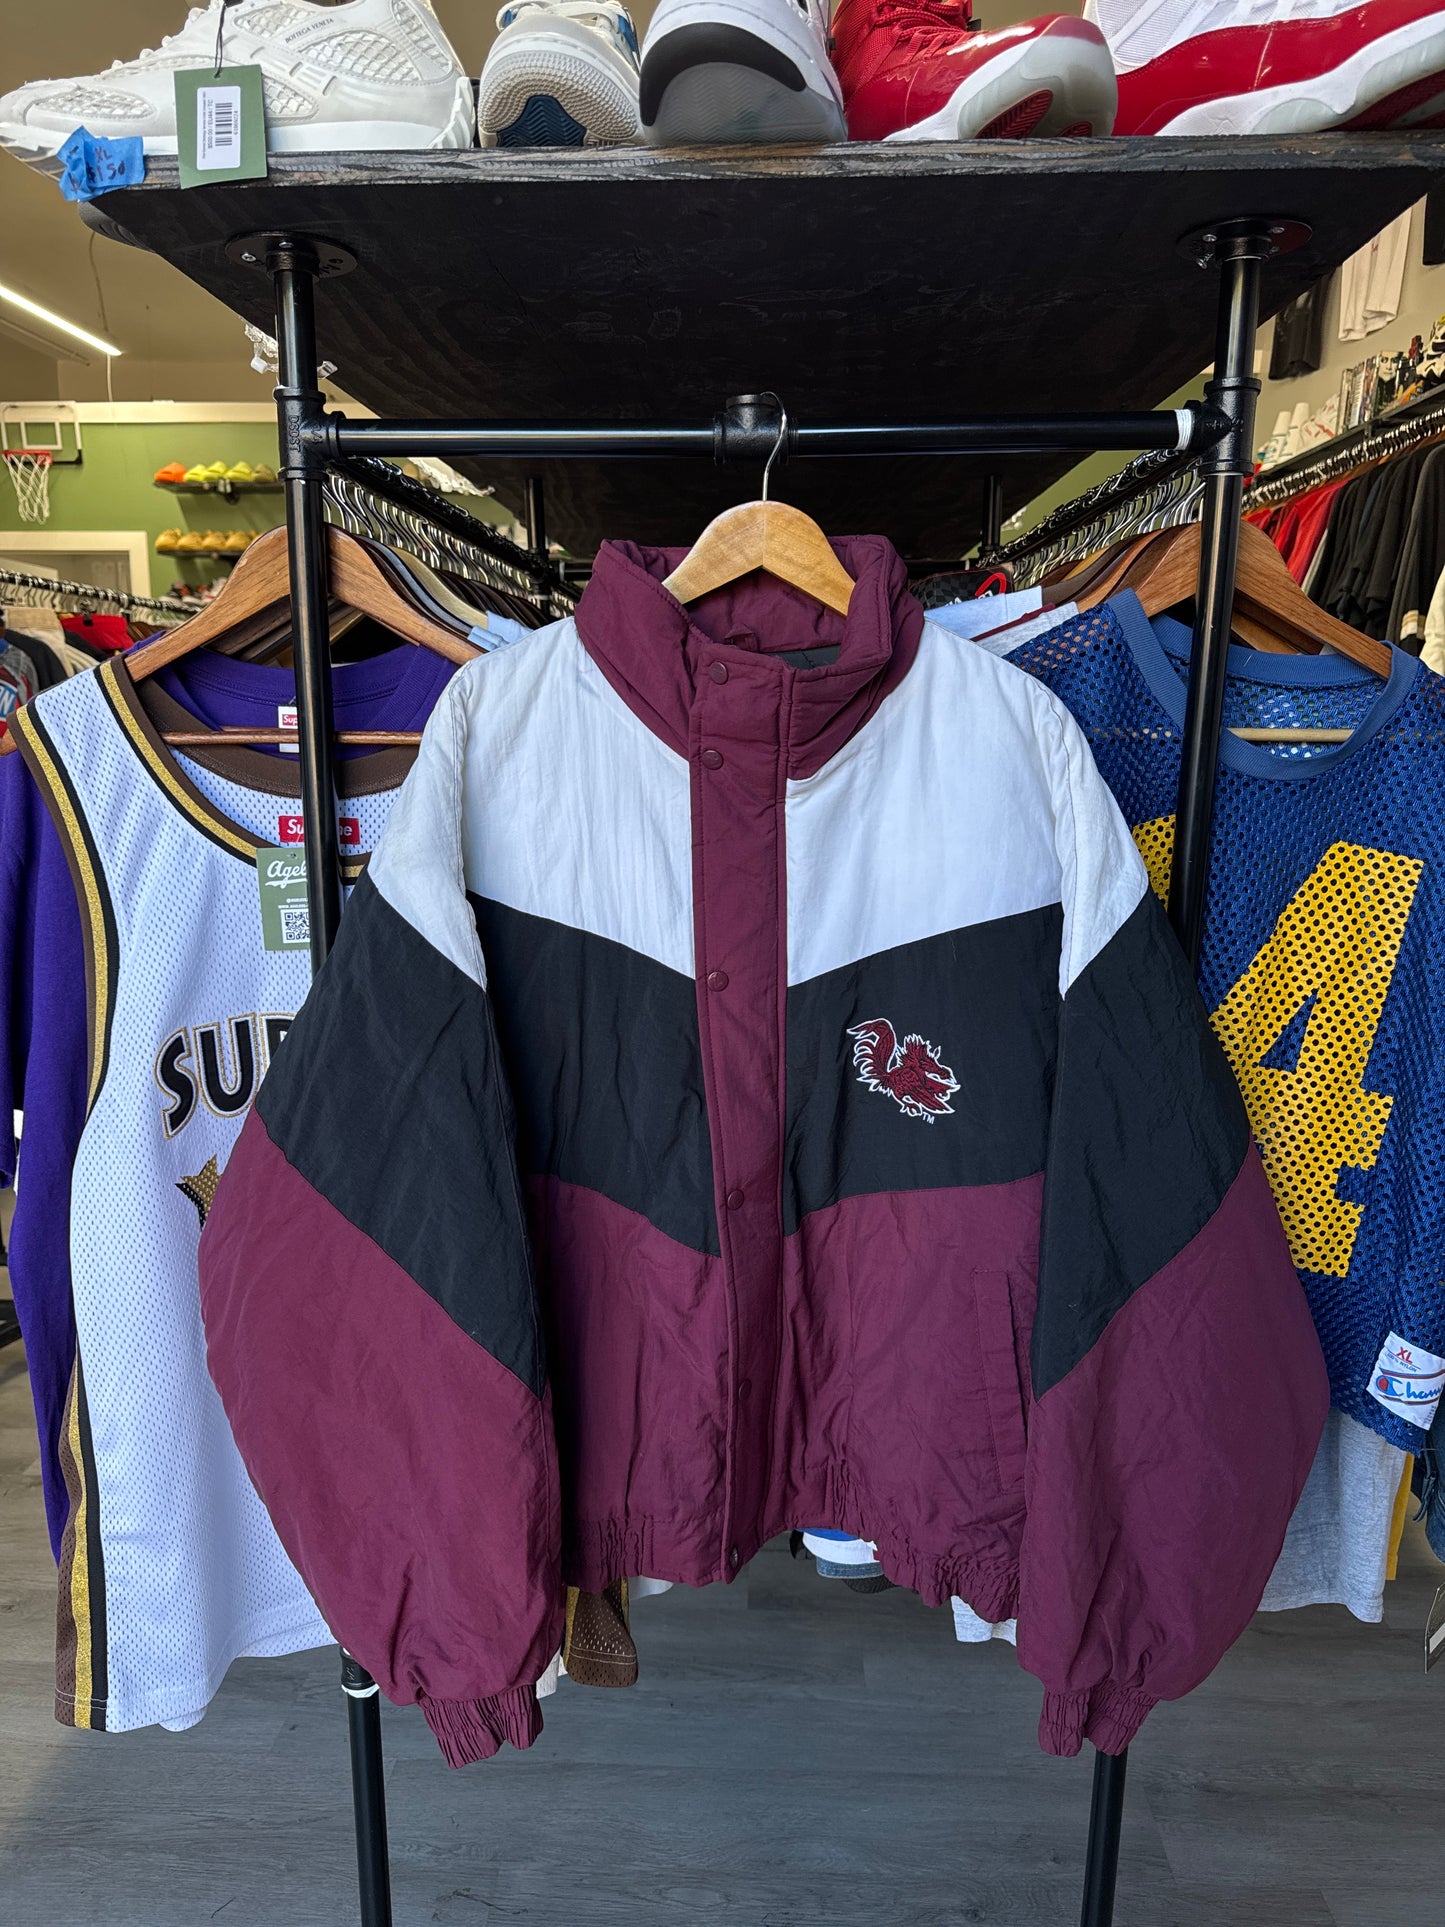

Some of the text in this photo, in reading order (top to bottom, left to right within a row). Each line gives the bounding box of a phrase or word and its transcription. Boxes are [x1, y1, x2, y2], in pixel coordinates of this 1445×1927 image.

[285, 18, 335, 43] BOTTEGA VENETA
[1208, 840, 1424, 1279] 4
[922, 1111, 935, 1125] TM
[1396, 1346, 1413, 1364] XL
